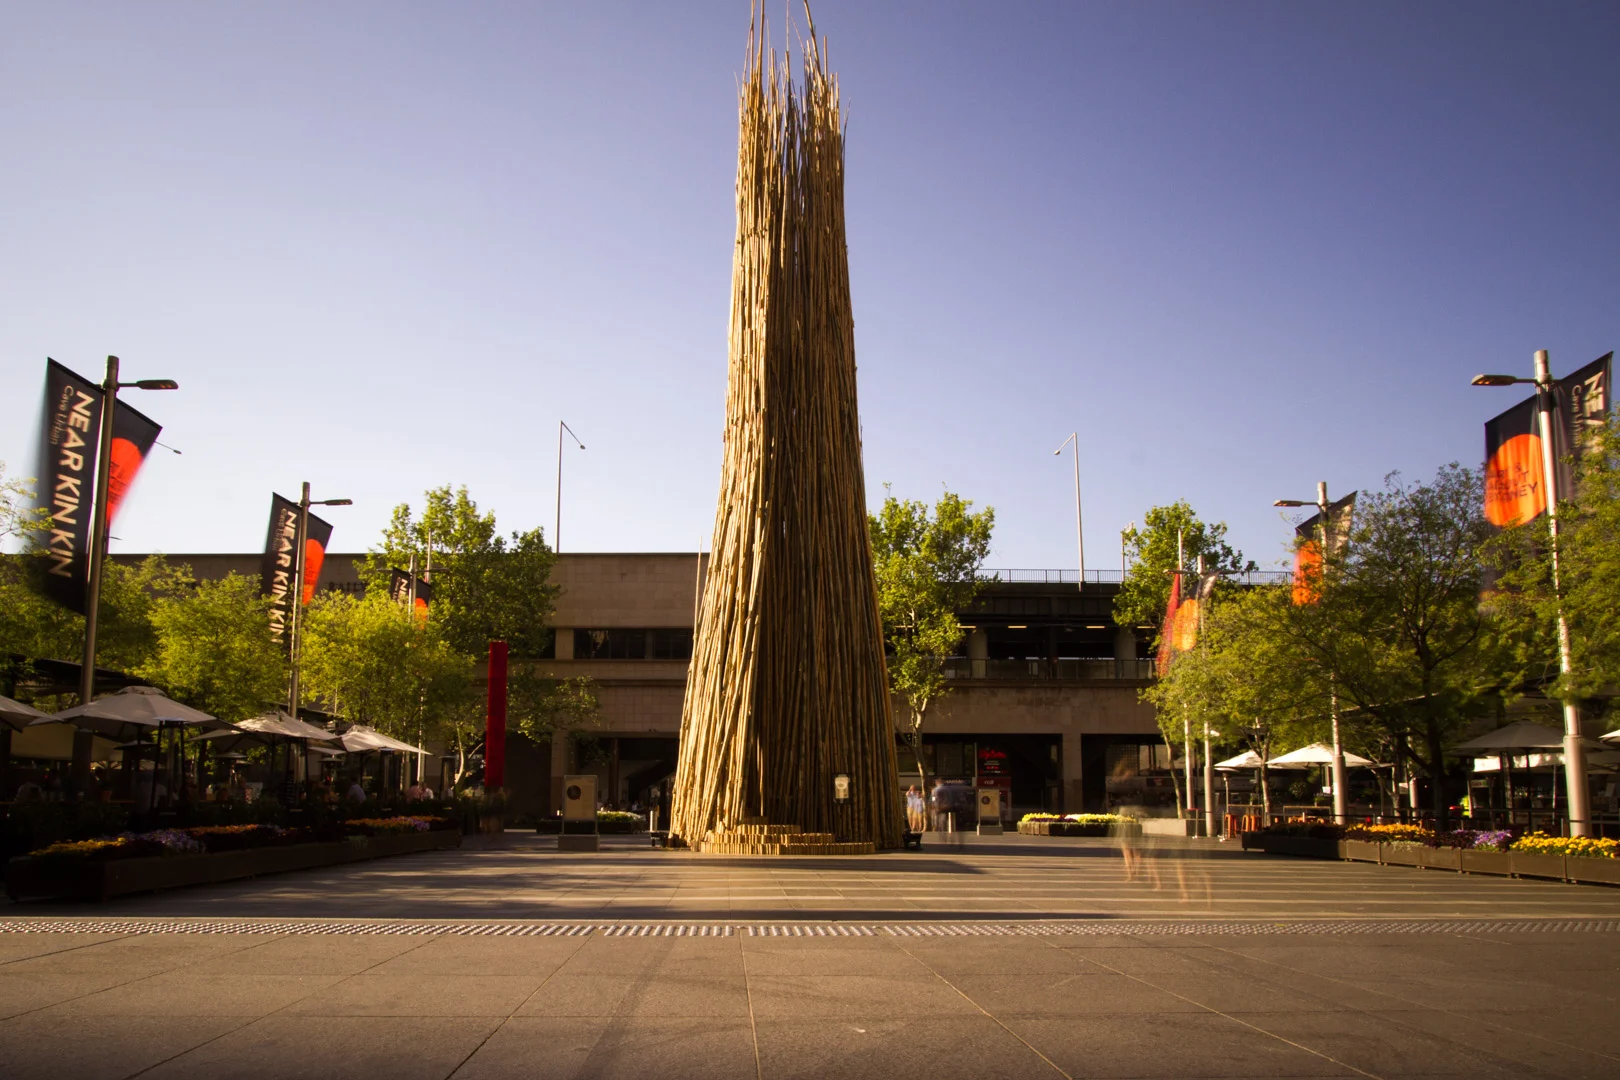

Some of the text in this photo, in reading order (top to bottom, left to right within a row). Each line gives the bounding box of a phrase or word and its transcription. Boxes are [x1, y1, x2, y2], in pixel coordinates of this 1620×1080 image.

[47, 390, 96, 578] NEAR KIN KIN
[275, 510, 298, 568] NEAR
[271, 569, 290, 606] KIN
